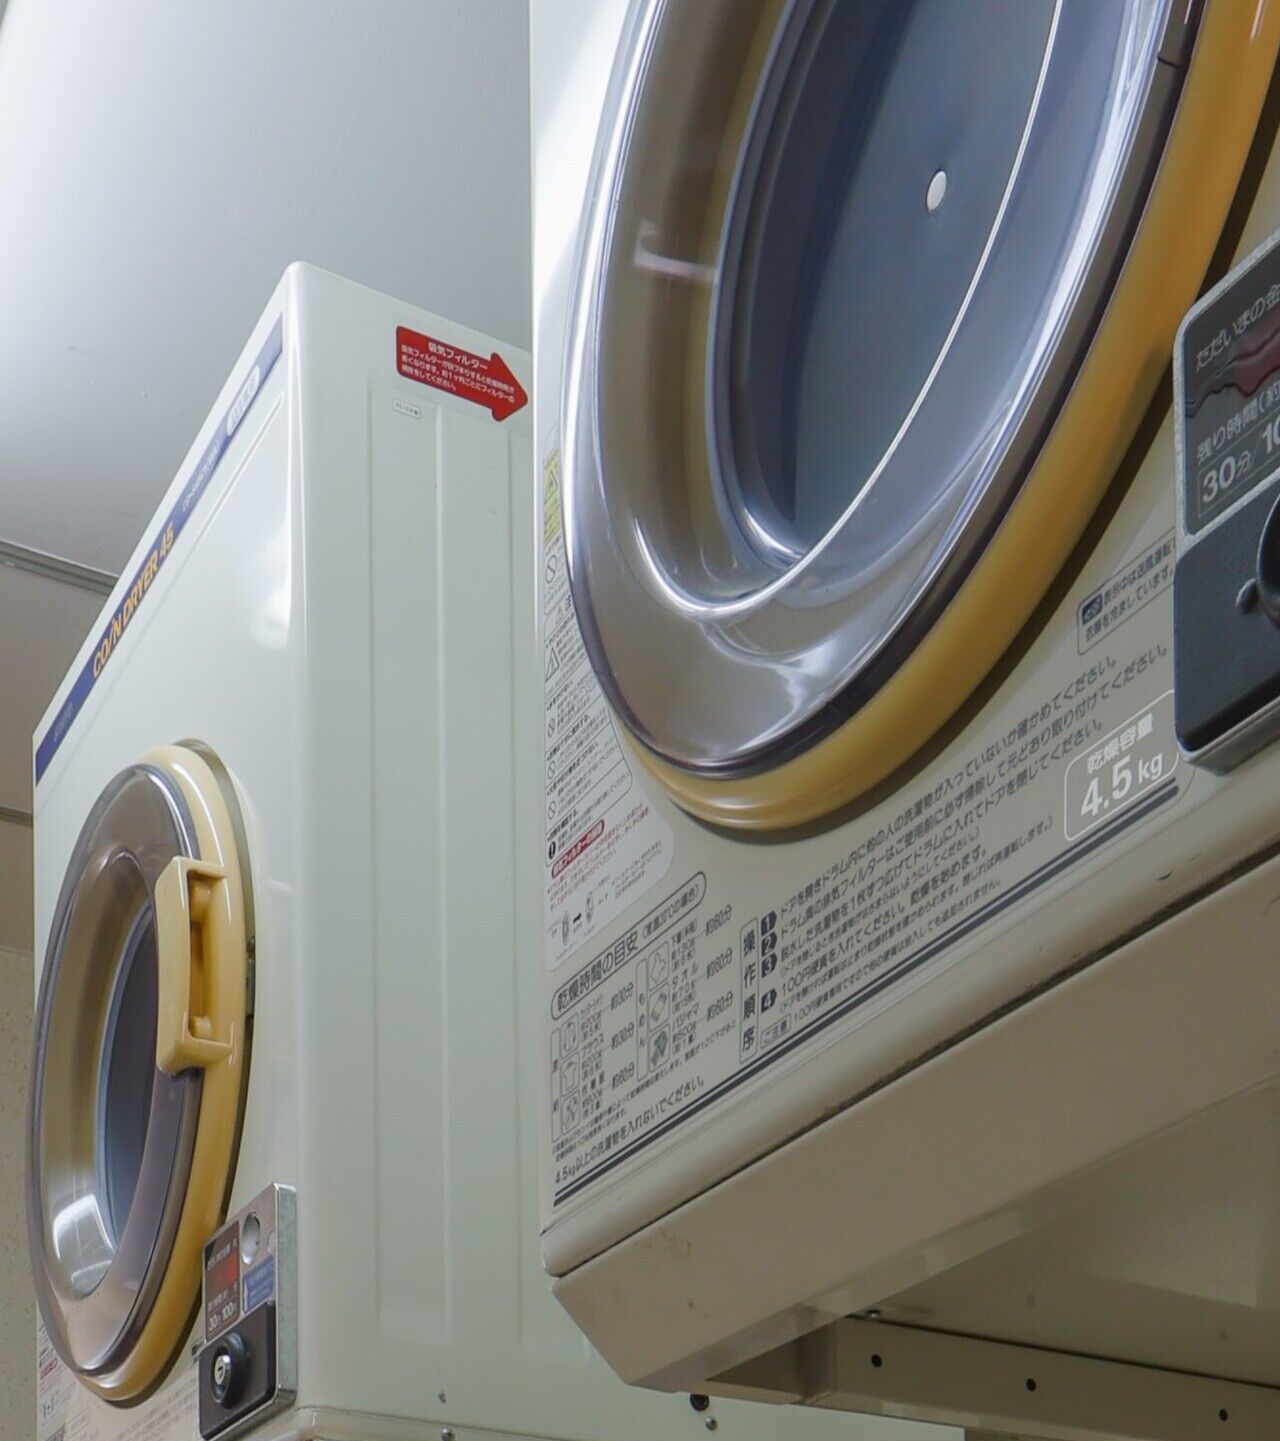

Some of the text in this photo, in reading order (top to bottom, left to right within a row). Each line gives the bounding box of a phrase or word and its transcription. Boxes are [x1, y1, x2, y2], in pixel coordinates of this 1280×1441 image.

[1087, 713, 1153, 774] 乾燥容量
[1081, 752, 1163, 816] 4.5 kg
[557, 930, 638, 1012] 乾燥時間の目安
